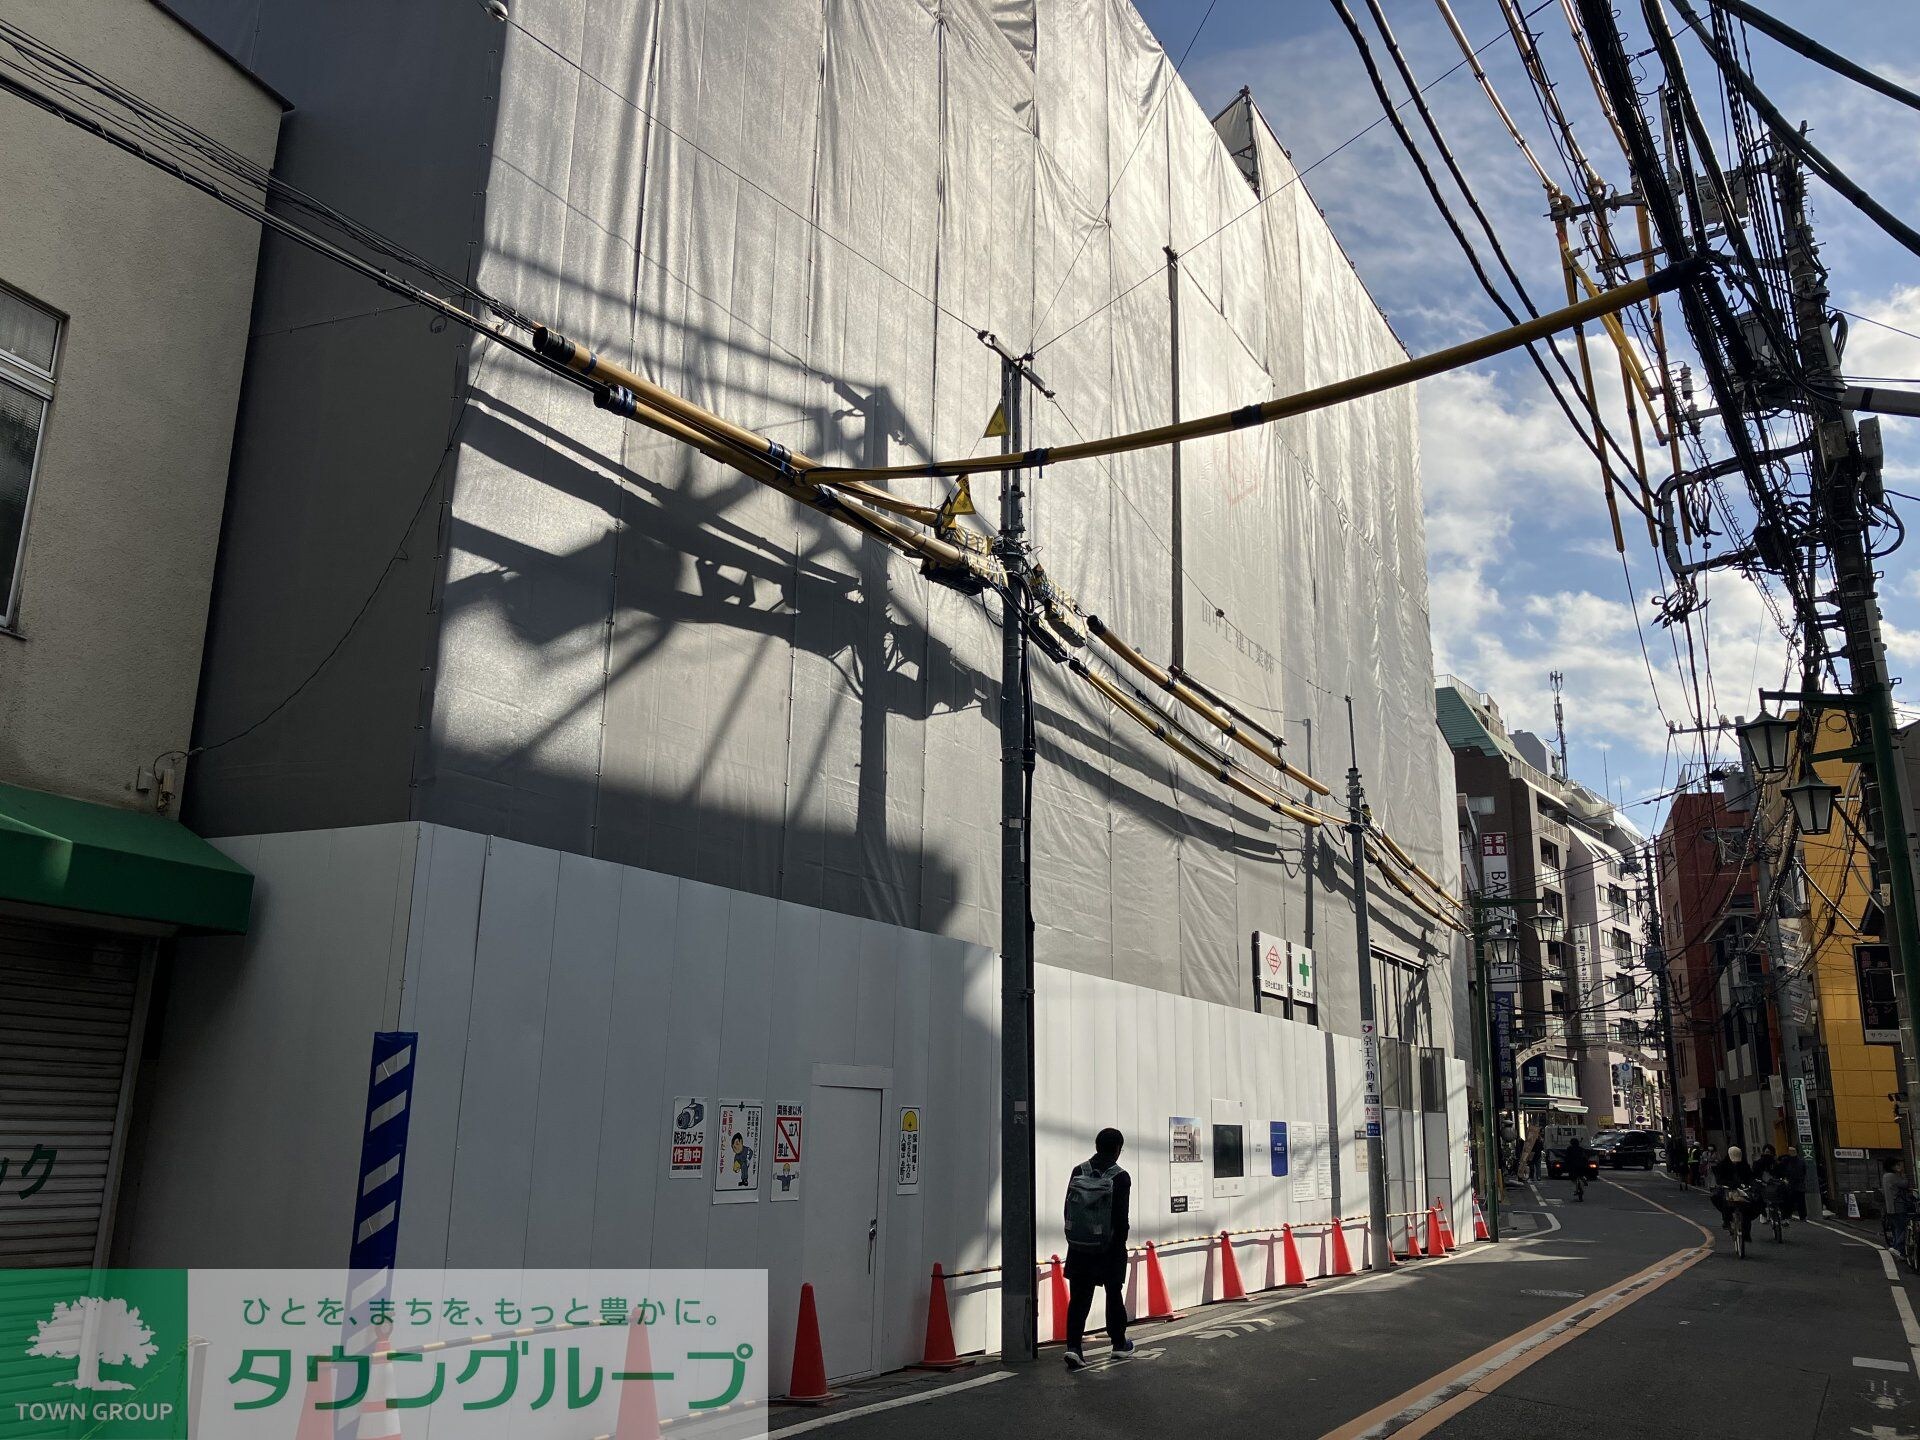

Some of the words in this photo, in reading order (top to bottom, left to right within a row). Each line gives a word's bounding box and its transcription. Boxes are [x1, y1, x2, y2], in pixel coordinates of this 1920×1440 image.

[1363, 1035, 1375, 1093] 京王不動産
[777, 1104, 802, 1116] 関係者以外
[789, 1122, 799, 1137] 立入
[674, 1131, 704, 1145] 防犯カメラ
[673, 1148, 702, 1162] 作動中
[778, 1142, 790, 1157] 禁止
[1803, 1148, 1814, 1159] 文
